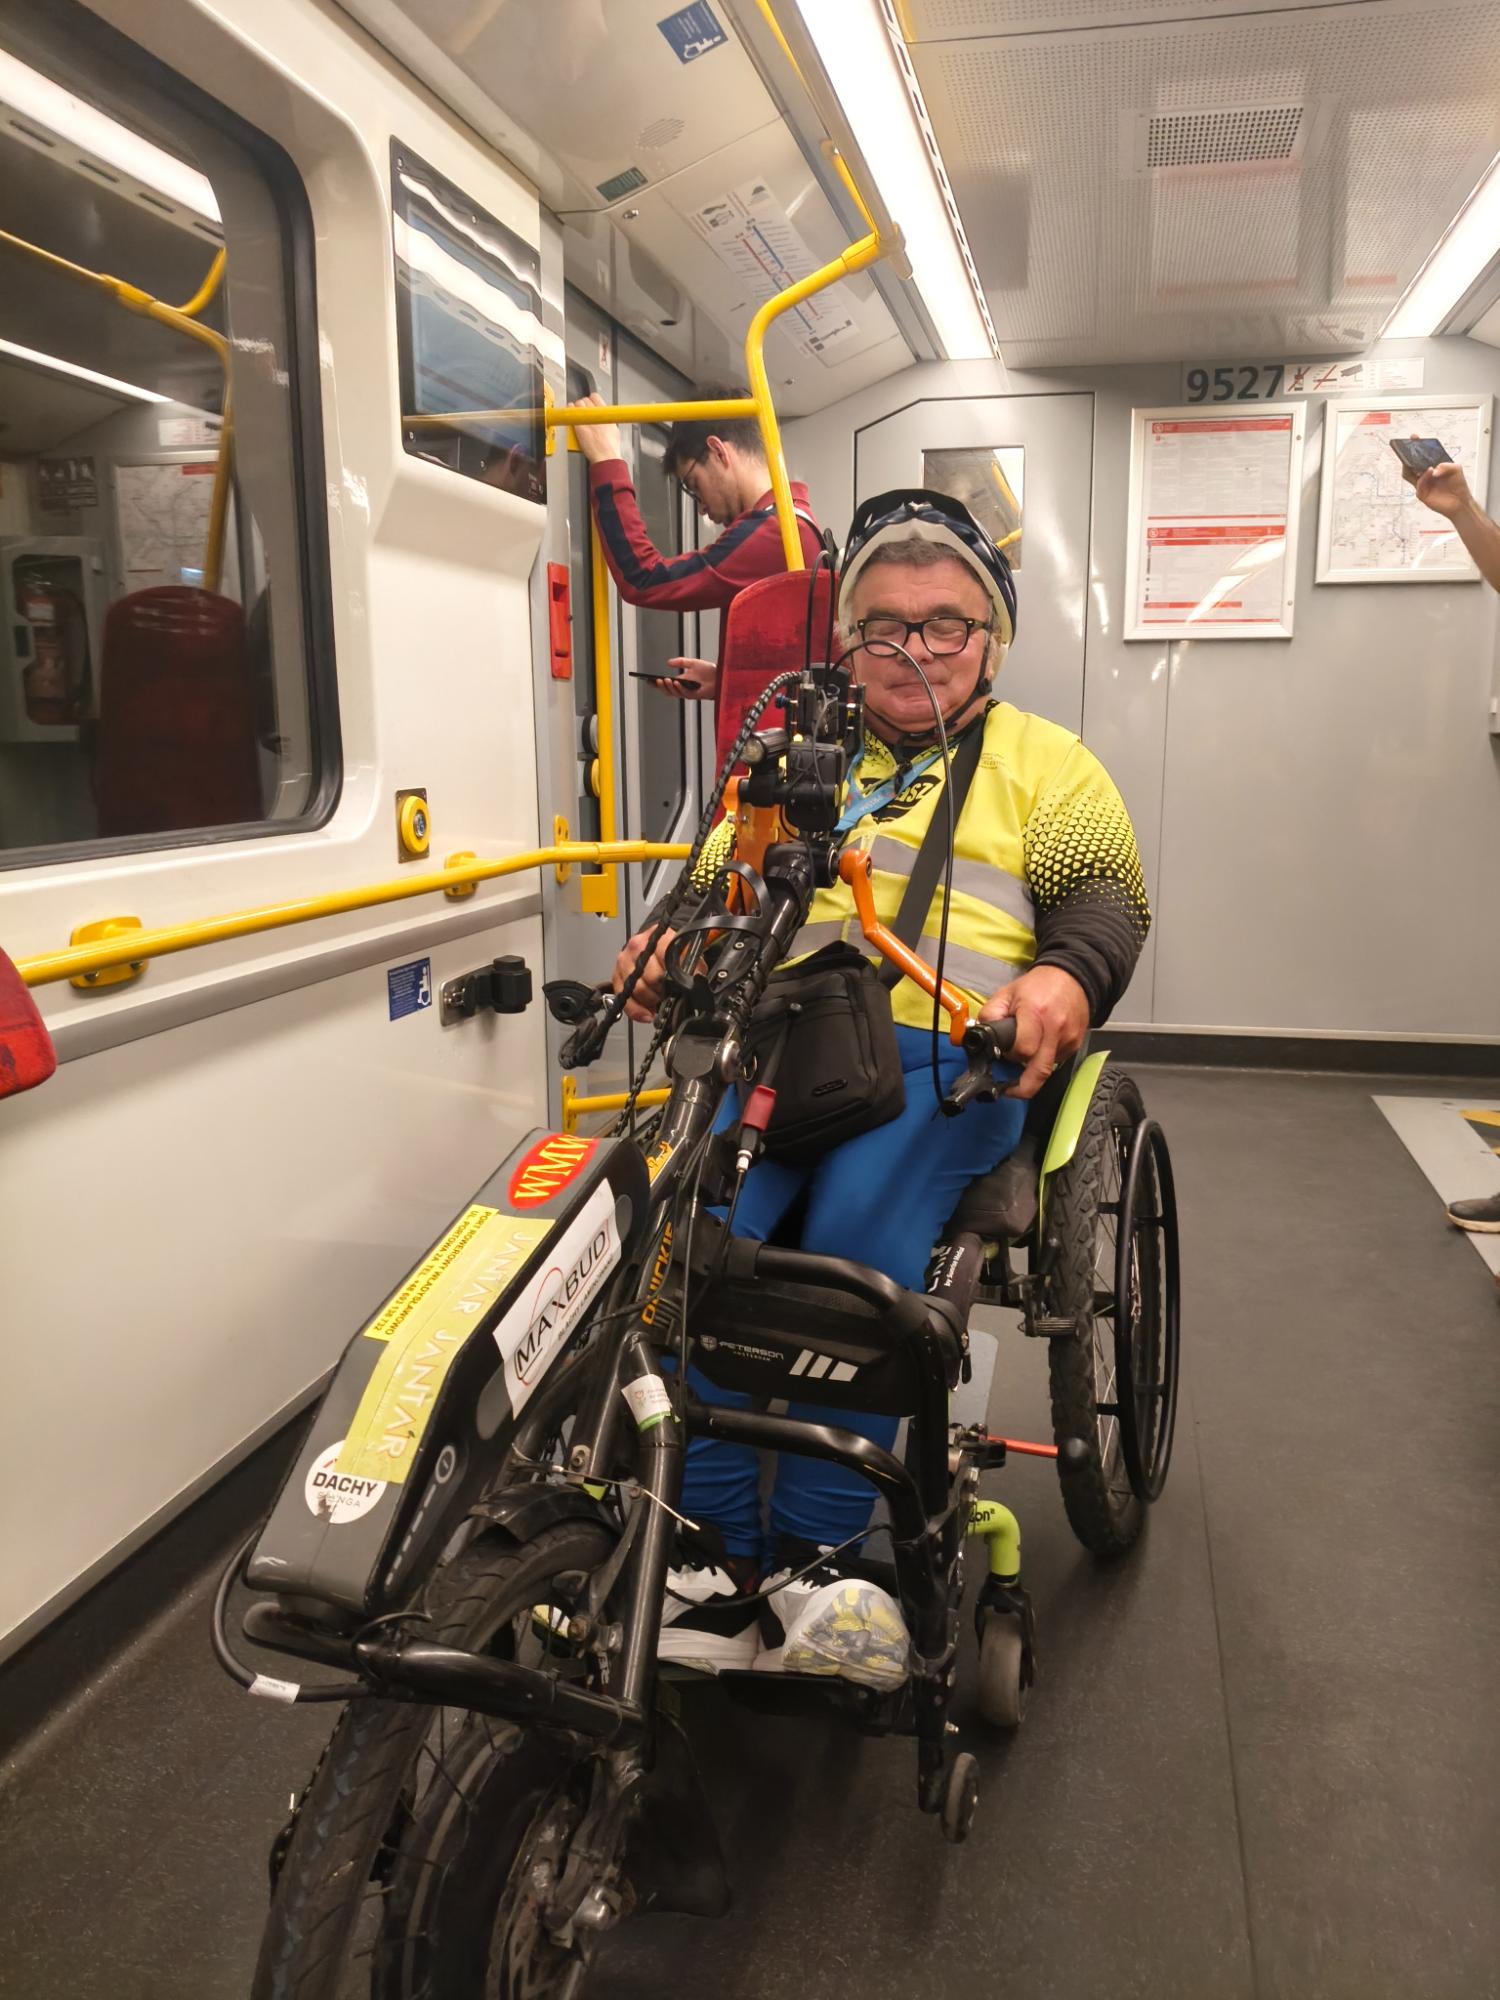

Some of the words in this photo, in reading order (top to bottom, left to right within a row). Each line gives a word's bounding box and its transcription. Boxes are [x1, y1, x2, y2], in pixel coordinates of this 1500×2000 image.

[1187, 365, 1284, 402] 9527
[440, 1221, 470, 1252] PORTOWA
[474, 1211, 492, 1229] PORT
[441, 1229, 476, 1270] ROWEROWY
[451, 1231, 534, 1315] JANTAR
[515, 1231, 606, 1372] MAXBUD
[719, 1341, 784, 1360] PETERSON
[376, 1329, 458, 1459] JANTAR
[312, 1472, 378, 1497] DACHY
